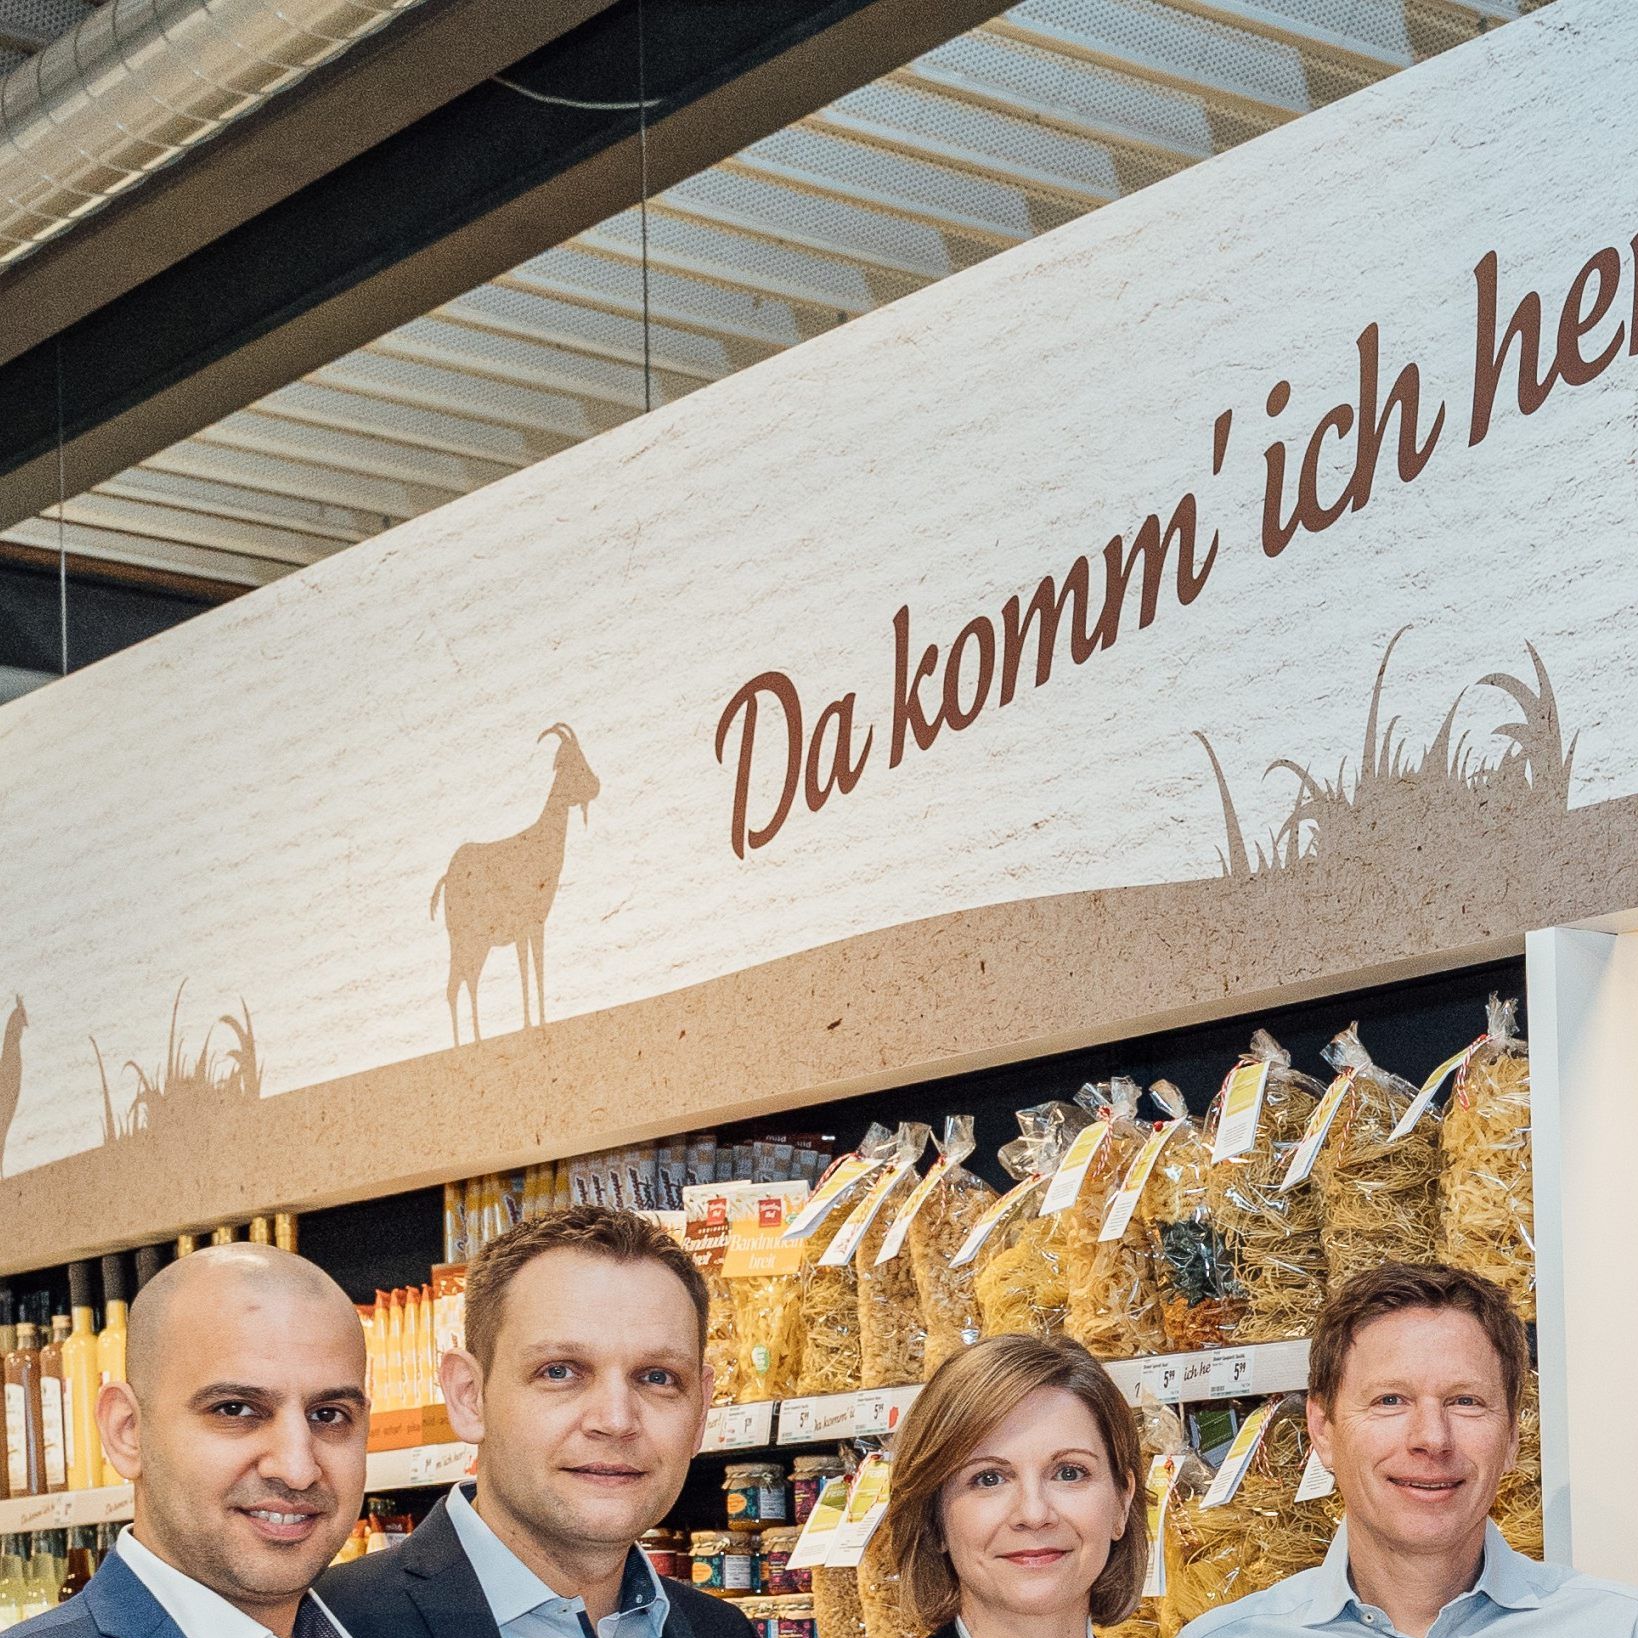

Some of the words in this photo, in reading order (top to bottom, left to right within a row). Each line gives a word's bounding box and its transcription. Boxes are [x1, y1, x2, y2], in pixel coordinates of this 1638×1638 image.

[715, 668, 873, 862] Da
[888, 409, 1234, 770] komm'
[1261, 321, 1447, 559] ich
[1184, 1364, 1198, 1381] ich
[1199, 1361, 1211, 1376] he
